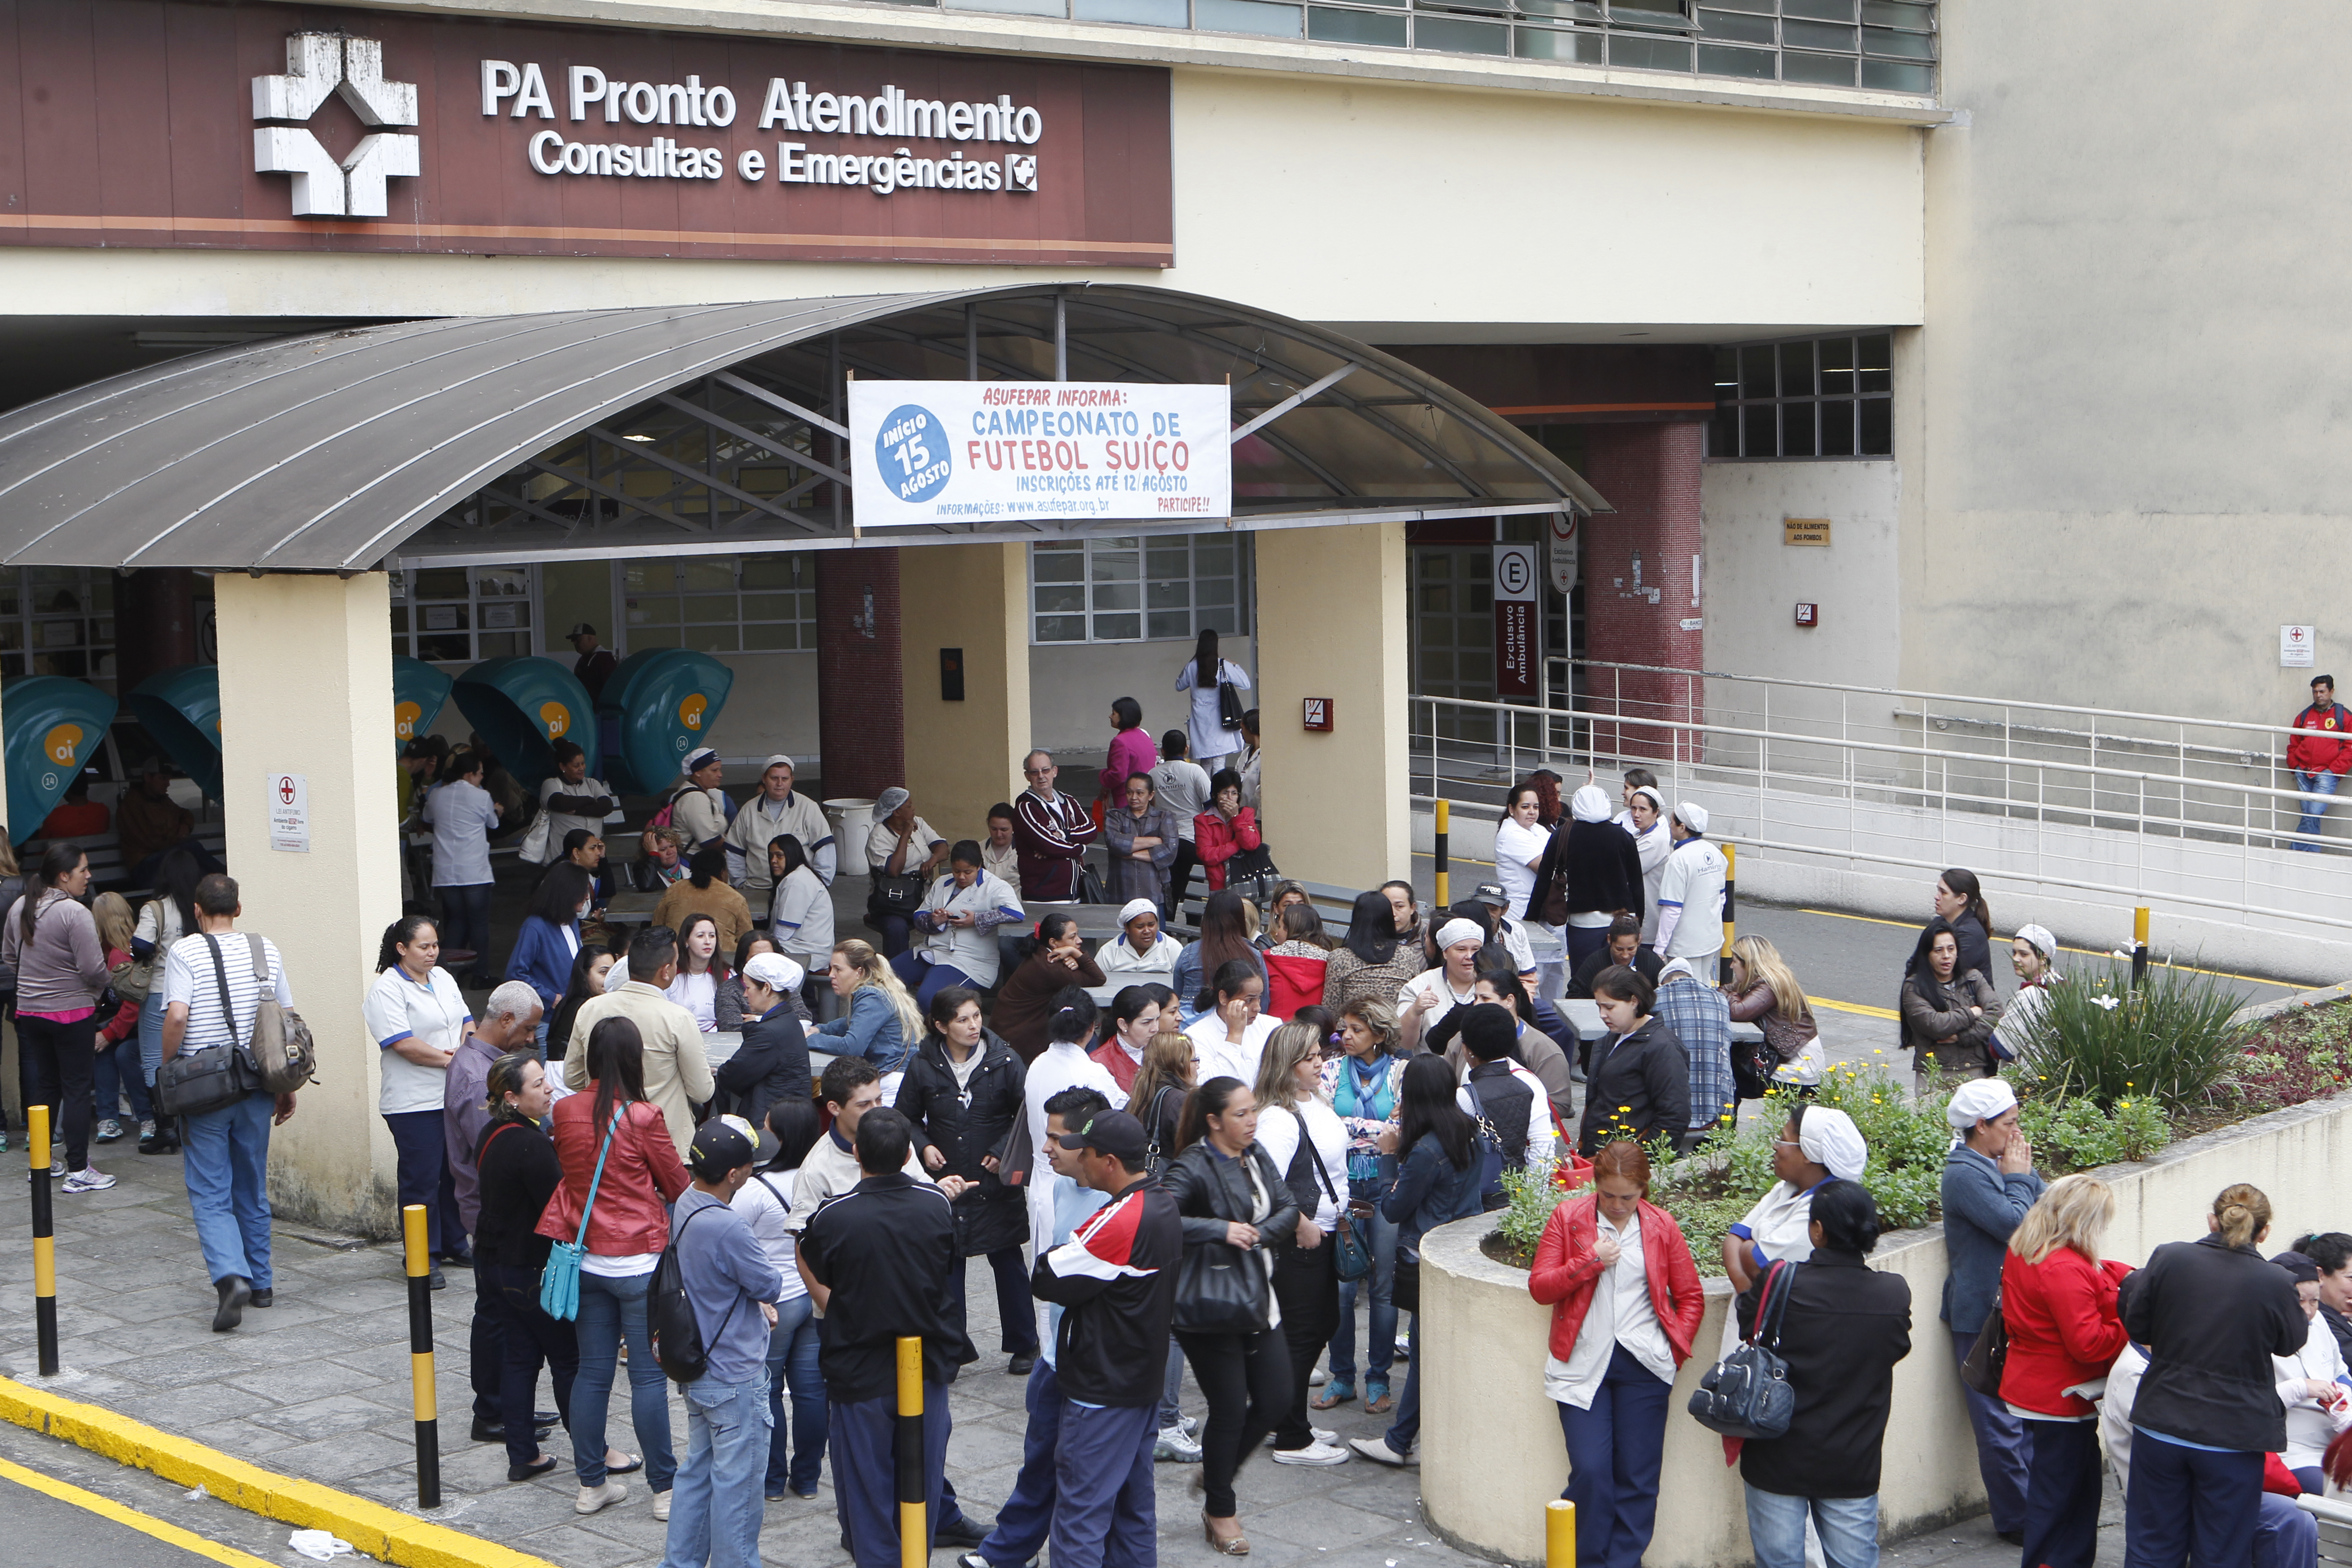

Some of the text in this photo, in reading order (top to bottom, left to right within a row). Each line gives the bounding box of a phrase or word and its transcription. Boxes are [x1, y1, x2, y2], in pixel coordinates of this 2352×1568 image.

[481, 60, 1042, 144] PA Pronto Atendimento
[528, 130, 1001, 195] Consultas e Emergências
[983, 388, 1127, 406] ASUFEPAR INFORMA:
[883, 413, 927, 449] INÍCIO
[972, 409, 1181, 437] CAMPEONATO DE
[894, 433, 930, 476] 15
[968, 434, 1189, 476] FUTEBOL SUÍÇO
[900, 460, 949, 499] AGOSTO
[1017, 471, 1090, 495] INSCRIÇÕES
[1096, 471, 1118, 492] ATÉ
[937, 500, 1005, 517] INFORMAÇÕES:
[1157, 496, 1210, 513] PARTICIPE!!
[1551, 557, 1576, 565] Ambulância
[1509, 563, 1521, 583] E
[1517, 606, 1526, 684] Ambulância
[398, 716, 413, 735] oi
[550, 715, 562, 733] oi
[687, 711, 701, 725] oi
[56, 739, 73, 760] oi
[46, 777, 55, 785] 14
